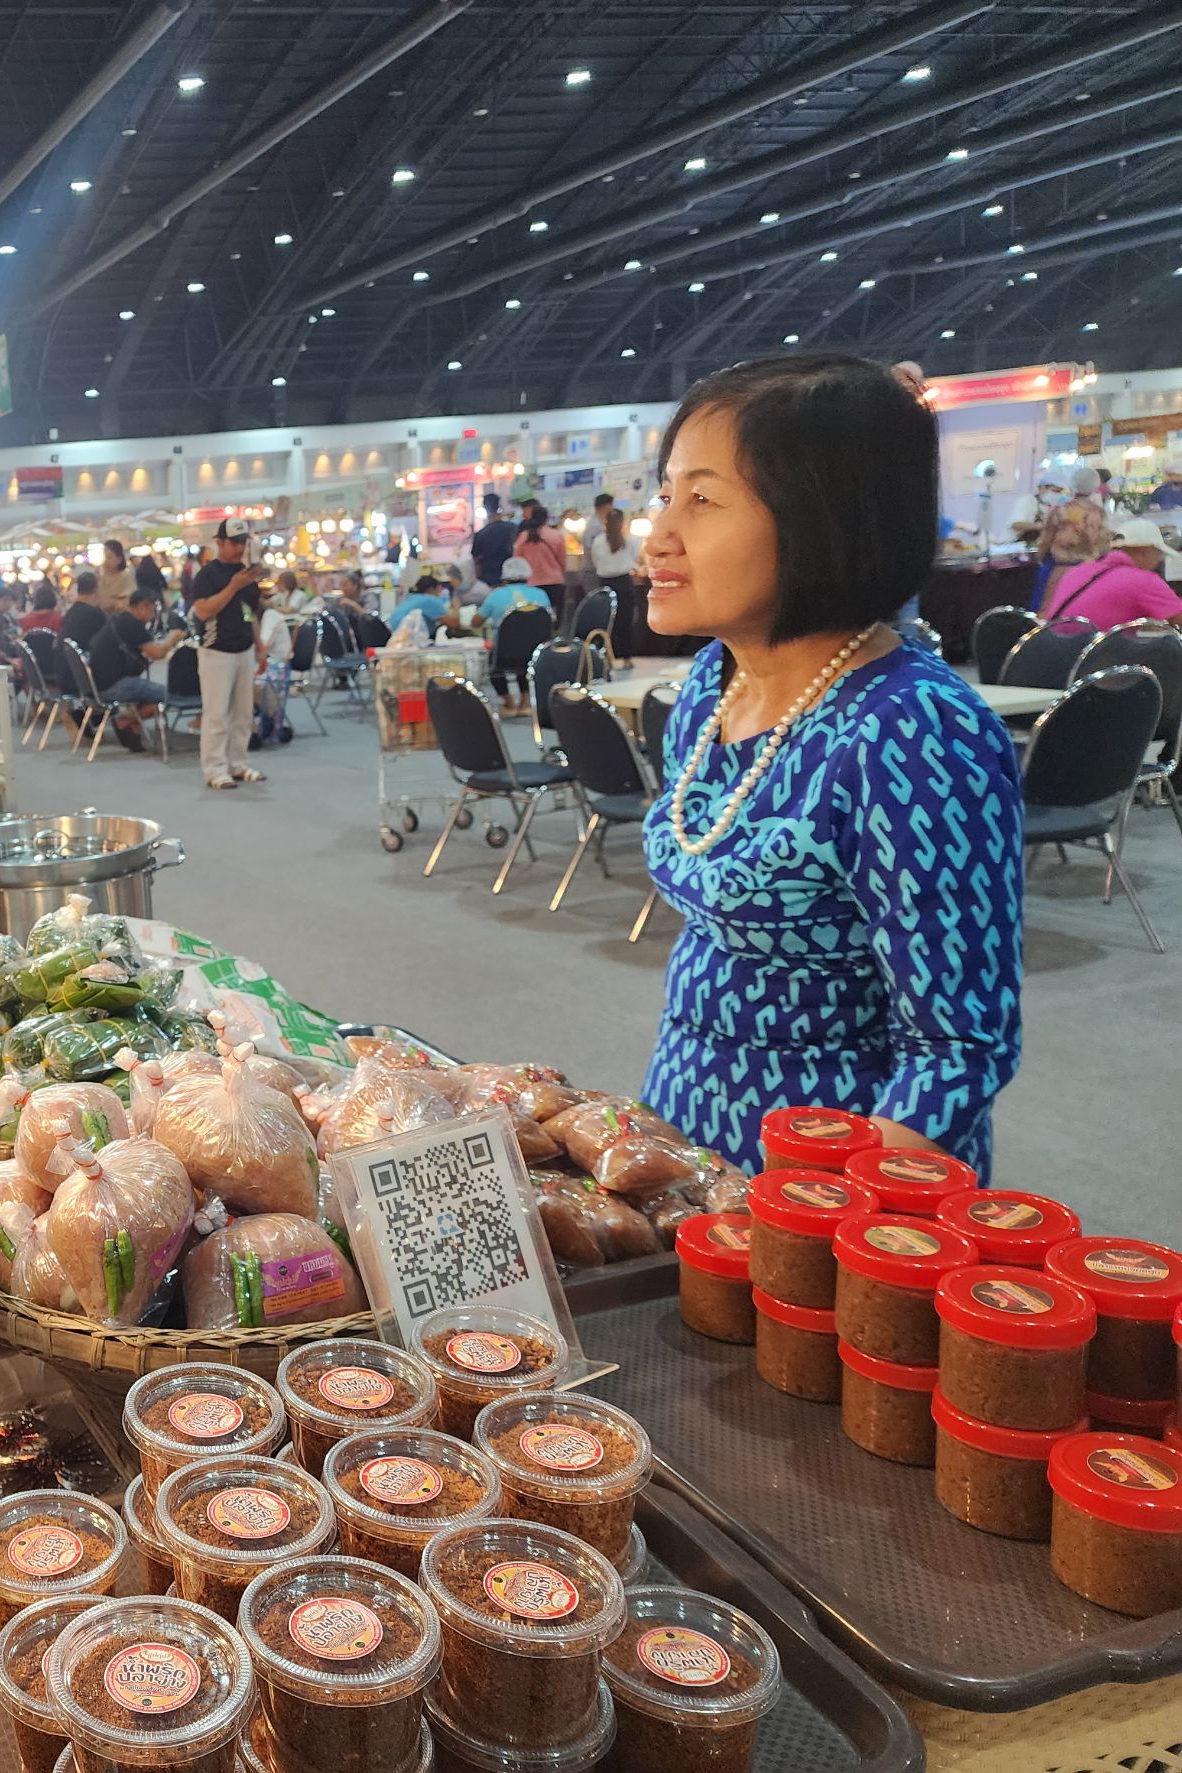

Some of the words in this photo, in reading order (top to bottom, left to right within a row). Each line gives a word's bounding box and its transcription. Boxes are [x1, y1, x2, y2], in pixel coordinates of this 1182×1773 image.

[299, 1609, 353, 1638] น้ำพริก
[122, 1656, 187, 1679] น้ำพริก
